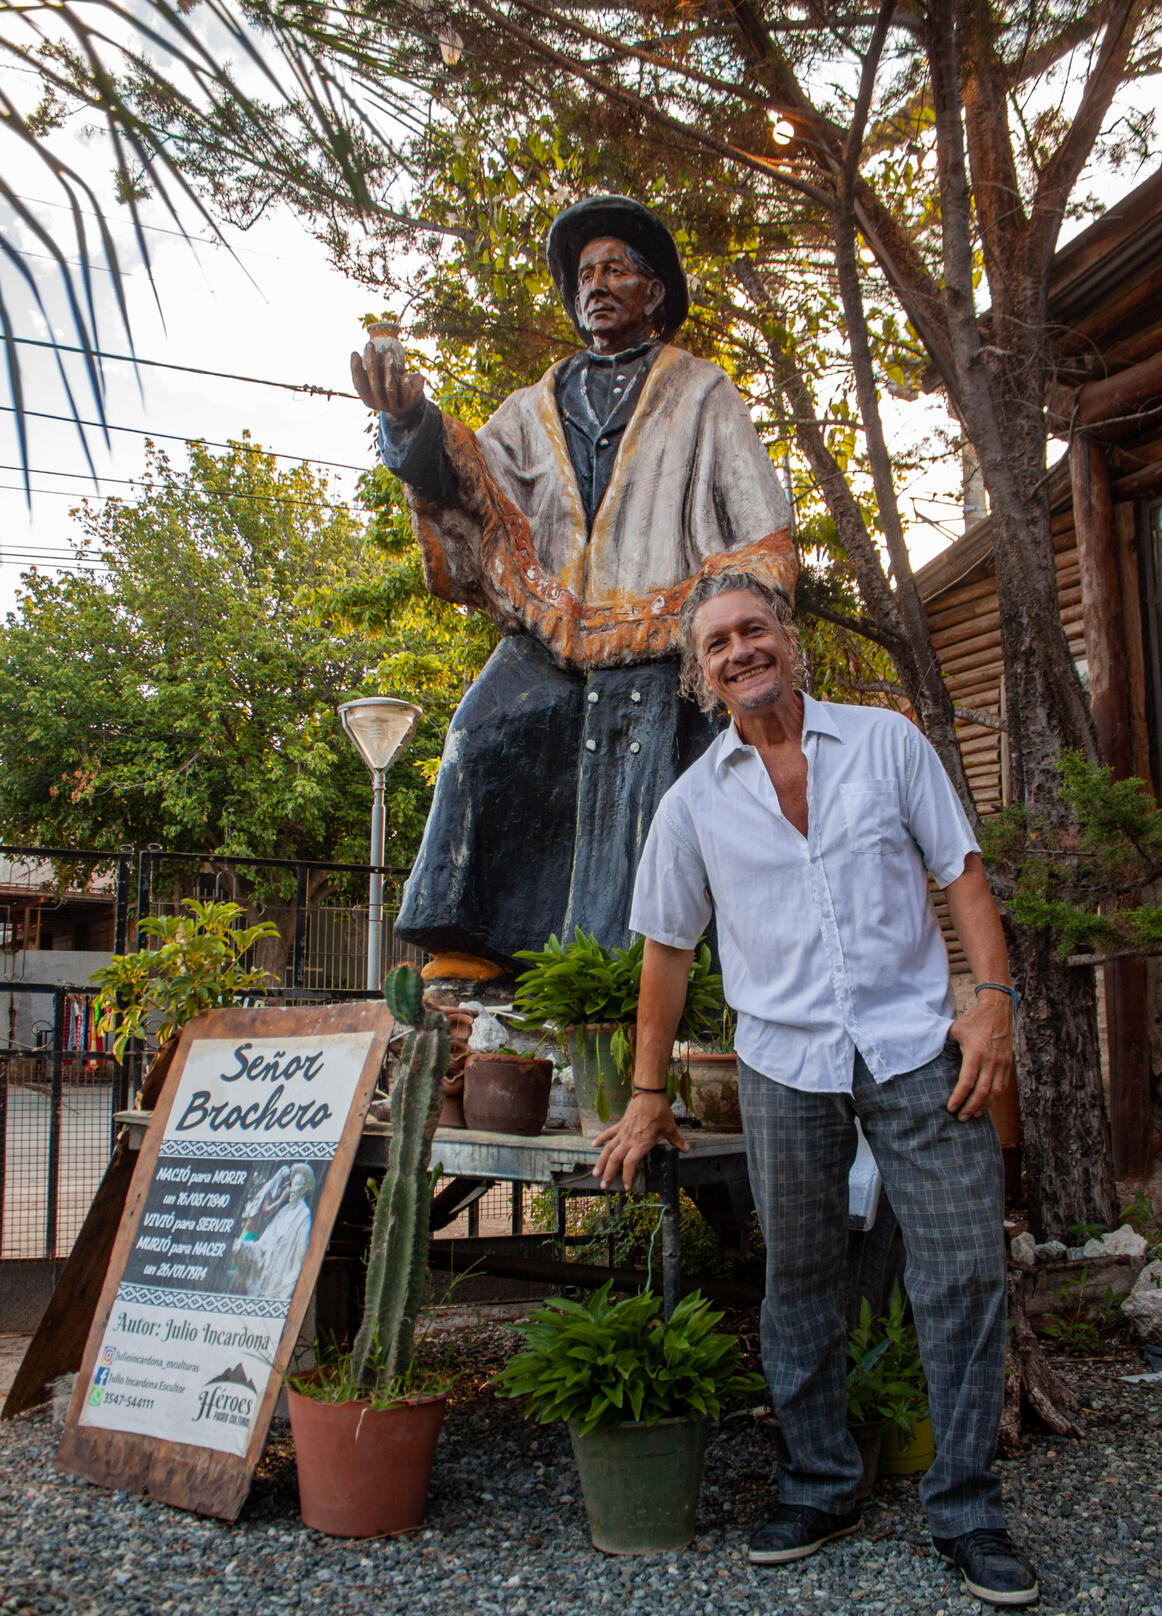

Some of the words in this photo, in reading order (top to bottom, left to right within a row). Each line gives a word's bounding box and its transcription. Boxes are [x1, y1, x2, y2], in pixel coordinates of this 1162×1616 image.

[219, 1043, 324, 1082] Señor
[175, 1084, 333, 1131] Brochero
[156, 1165, 191, 1181] NACIÓ
[187, 1173, 212, 1186] para
[211, 1170, 248, 1185] MORIR
[162, 1194, 177, 1205] un
[176, 1191, 231, 1208] 16/03/1840
[143, 1211, 176, 1228] VIVIÓ
[171, 1219, 196, 1233] para
[196, 1217, 234, 1232] SERVIR
[136, 1235, 172, 1252] MURIÓ
[168, 1243, 192, 1257] para
[191, 1241, 226, 1257] NACER
[143, 1264, 157, 1275] un
[156, 1262, 208, 1280] 26/01/1914
[113, 1312, 161, 1337] Autor:
[161, 1319, 198, 1343] Julio
[202, 1323, 271, 1351] Incardona
[108, 1372, 125, 1385] Julio
[125, 1377, 158, 1390] Incardona
[158, 1381, 186, 1394] Escultor
[103, 1392, 155, 1409] 3547-544111
[191, 1386, 253, 1422] Héroes
